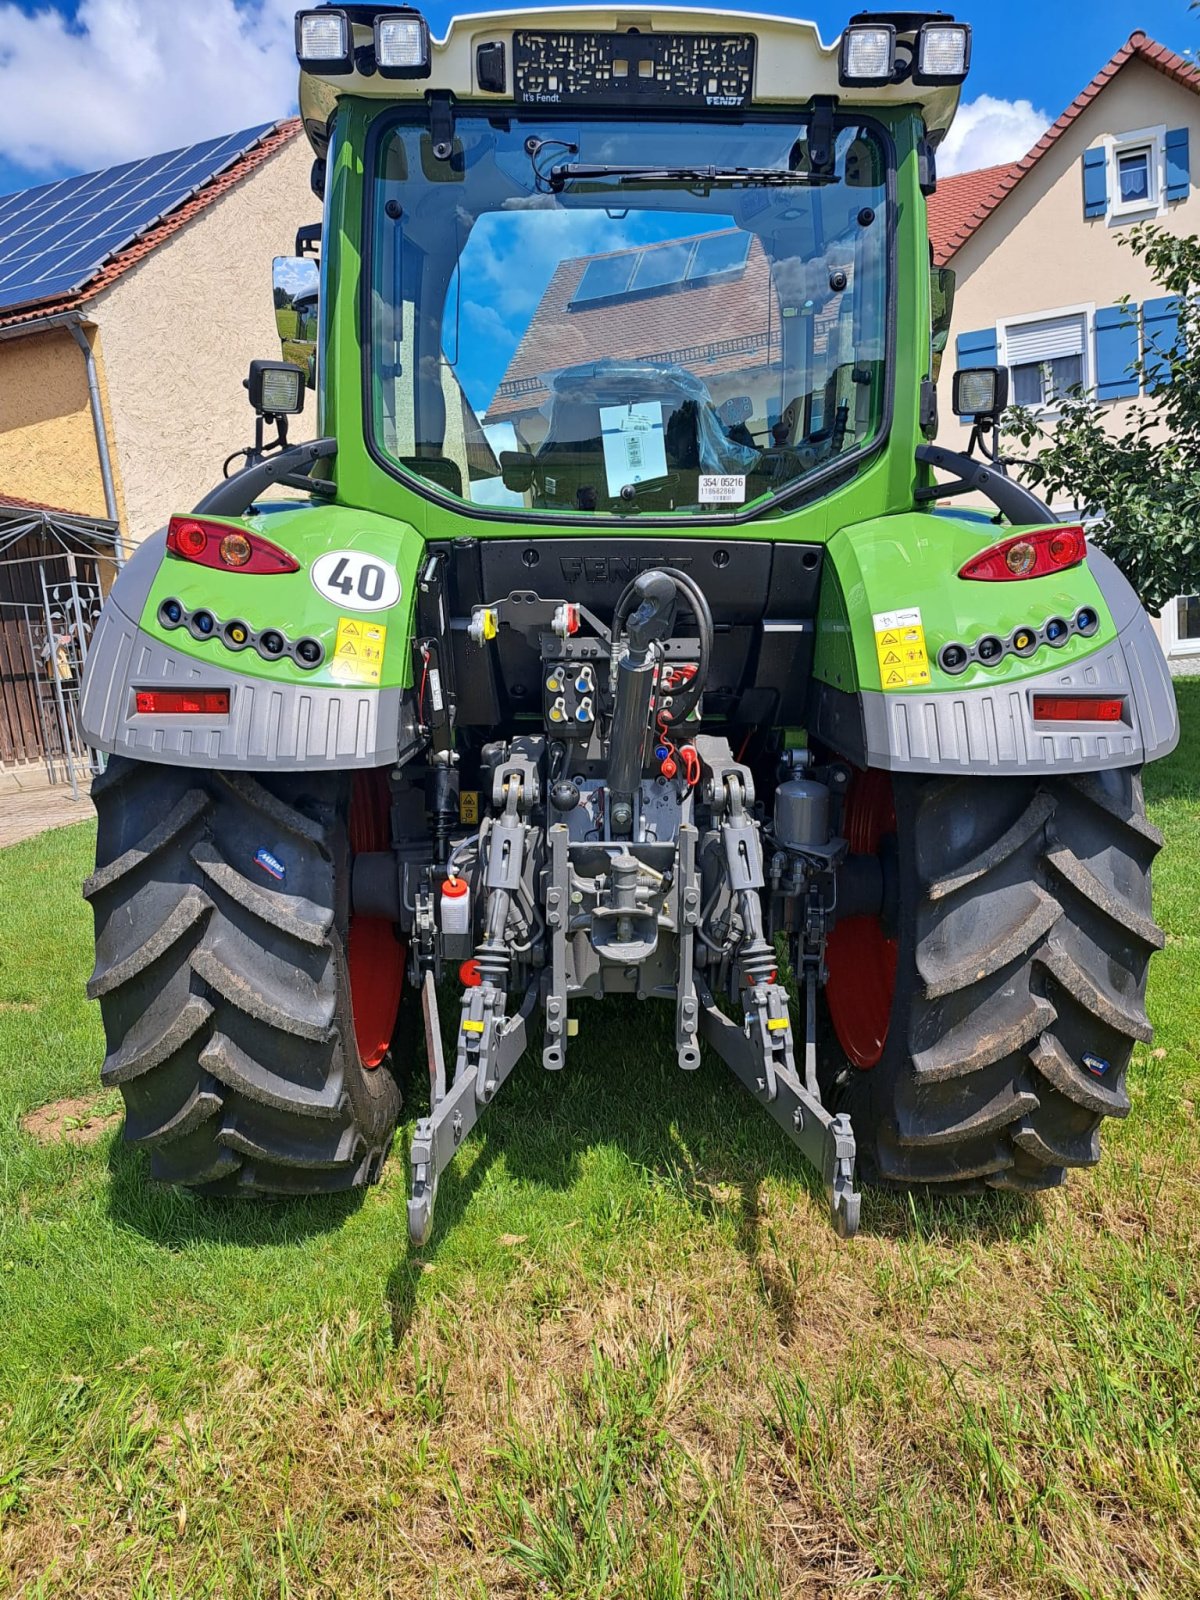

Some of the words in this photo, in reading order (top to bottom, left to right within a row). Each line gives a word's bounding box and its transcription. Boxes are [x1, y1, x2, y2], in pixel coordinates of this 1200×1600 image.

[523, 93, 534, 102] It's
[536, 93, 561, 103] Fendt.
[706, 96, 744, 106] FENDT
[327, 557, 386, 601] 40
